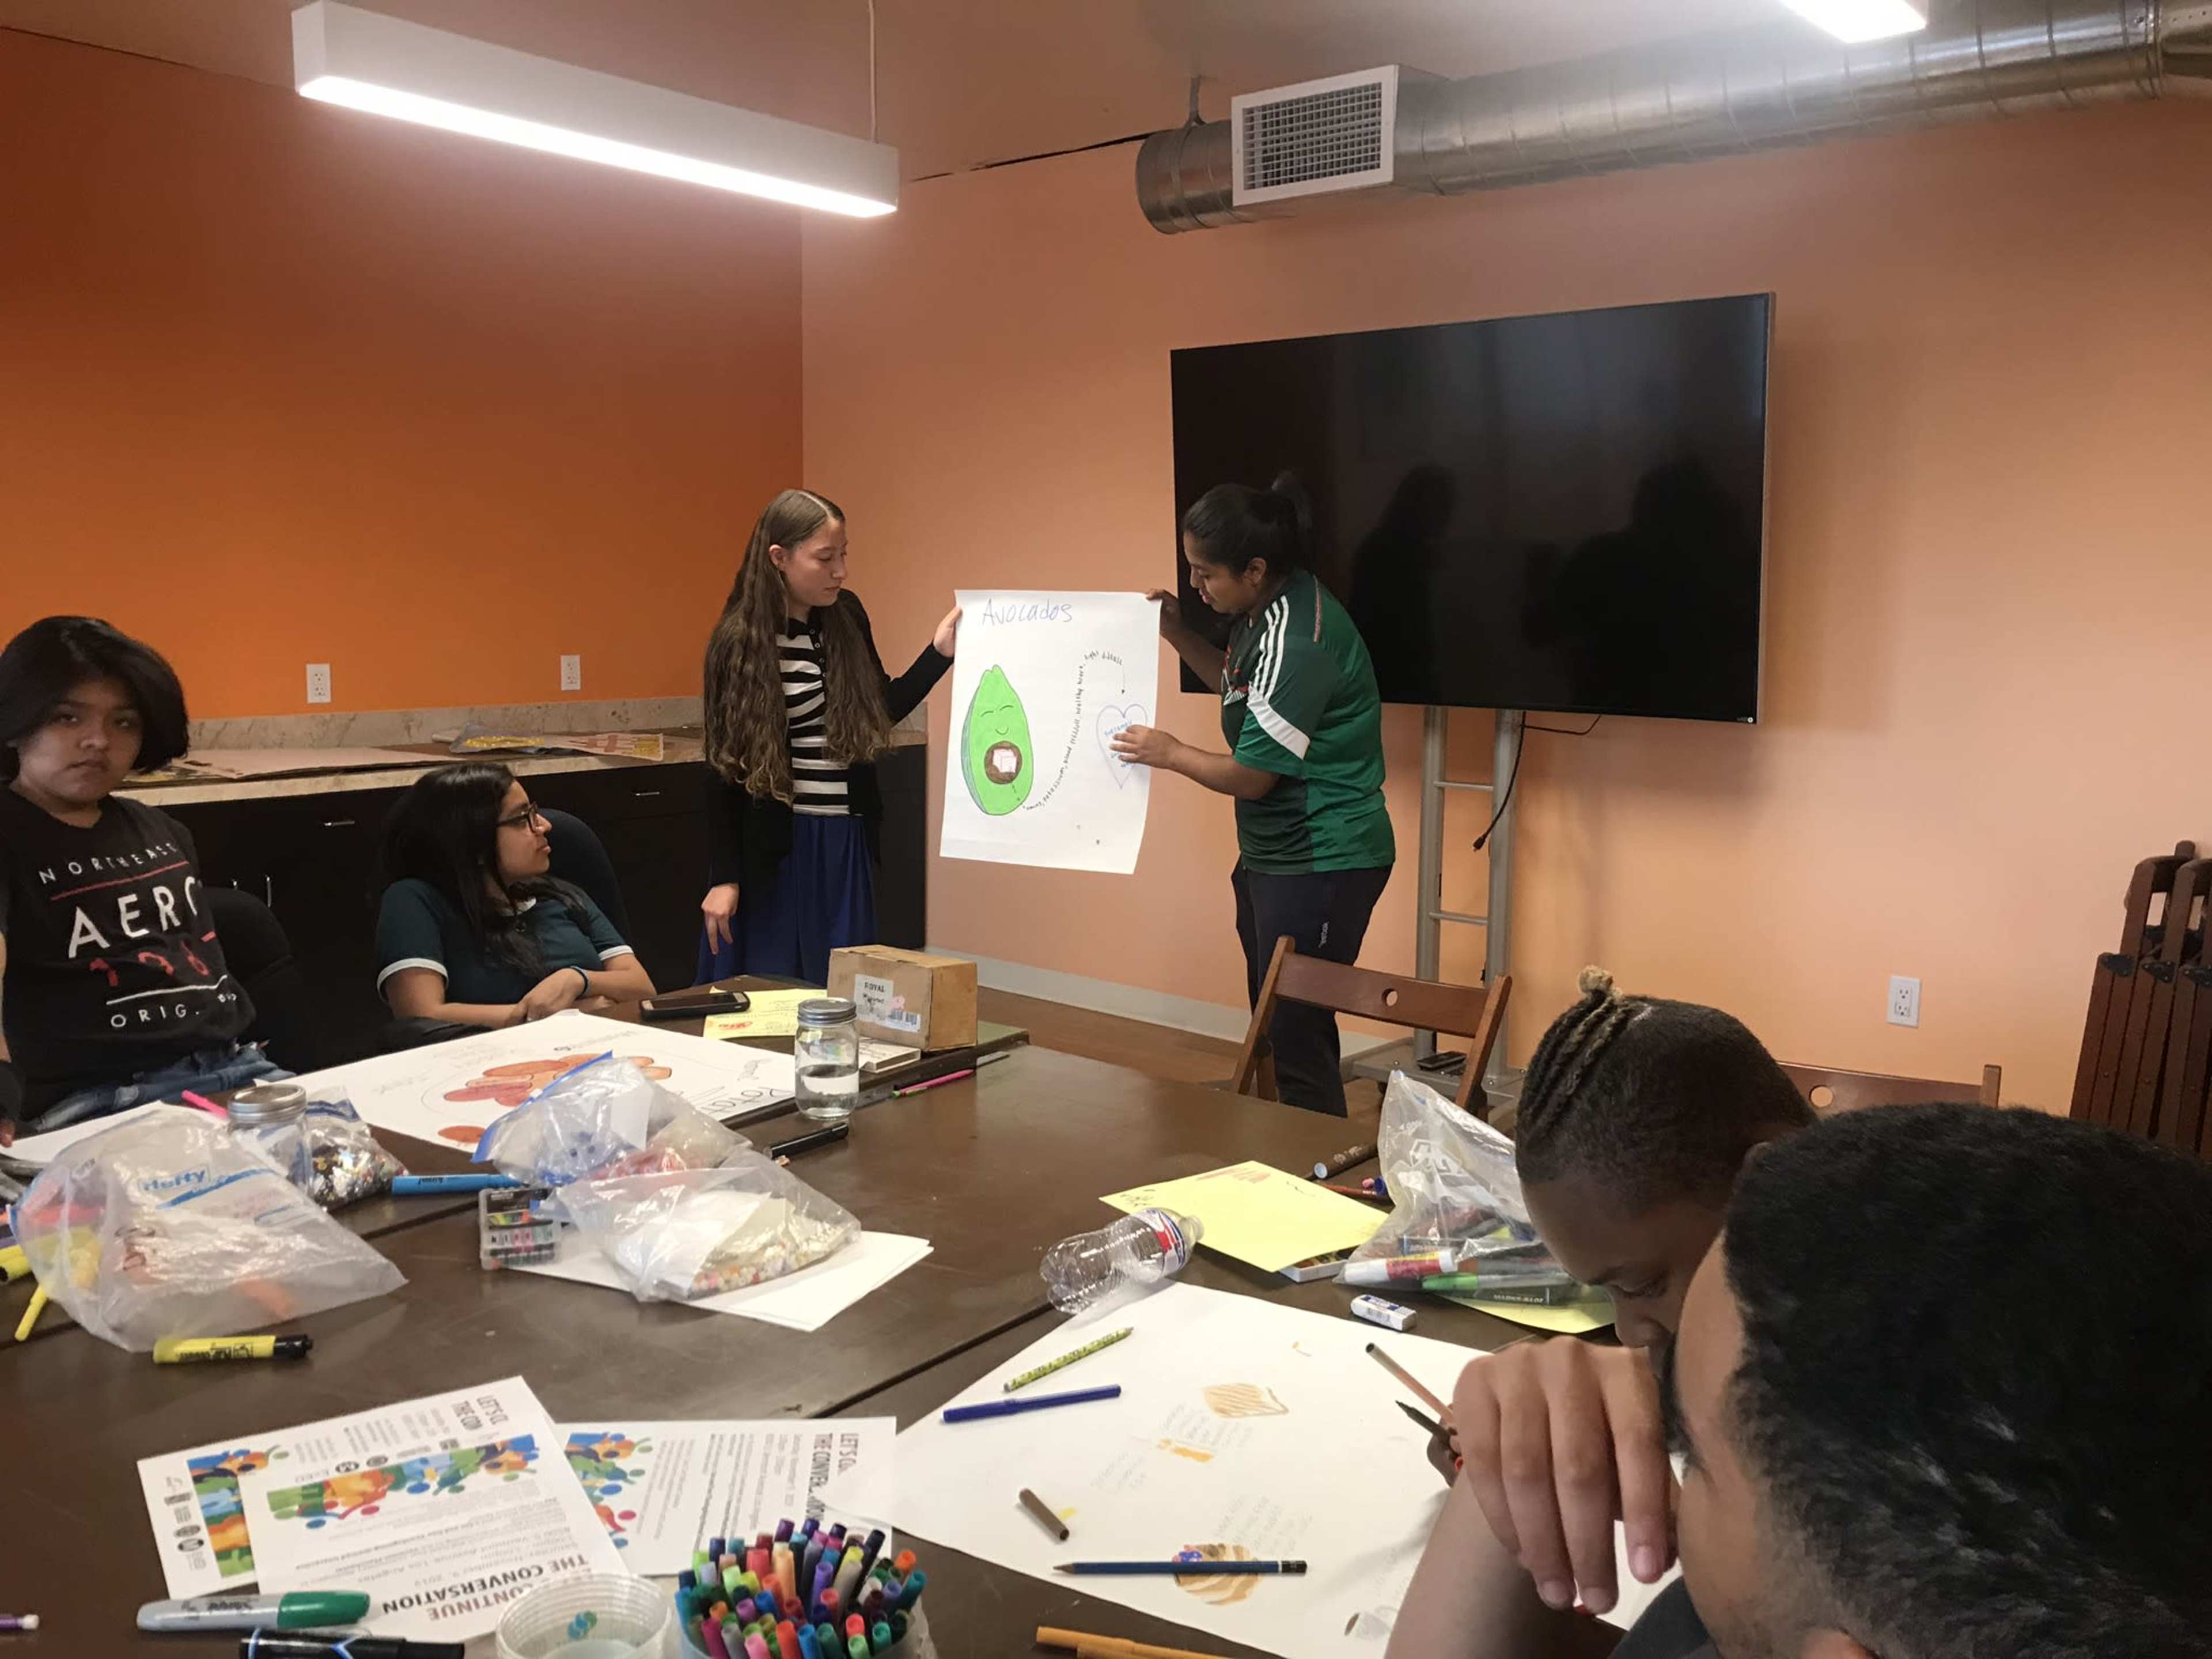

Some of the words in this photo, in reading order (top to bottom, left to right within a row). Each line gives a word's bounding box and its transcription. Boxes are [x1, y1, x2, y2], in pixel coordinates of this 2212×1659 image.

[981, 599, 1073, 626] Avocados
[39, 842, 179, 885] NORTHEAST
[111, 1003, 200, 1028] ORIG.
[547, 1554, 589, 1573] THE
[381, 1565, 544, 1615] CONVERSATION
